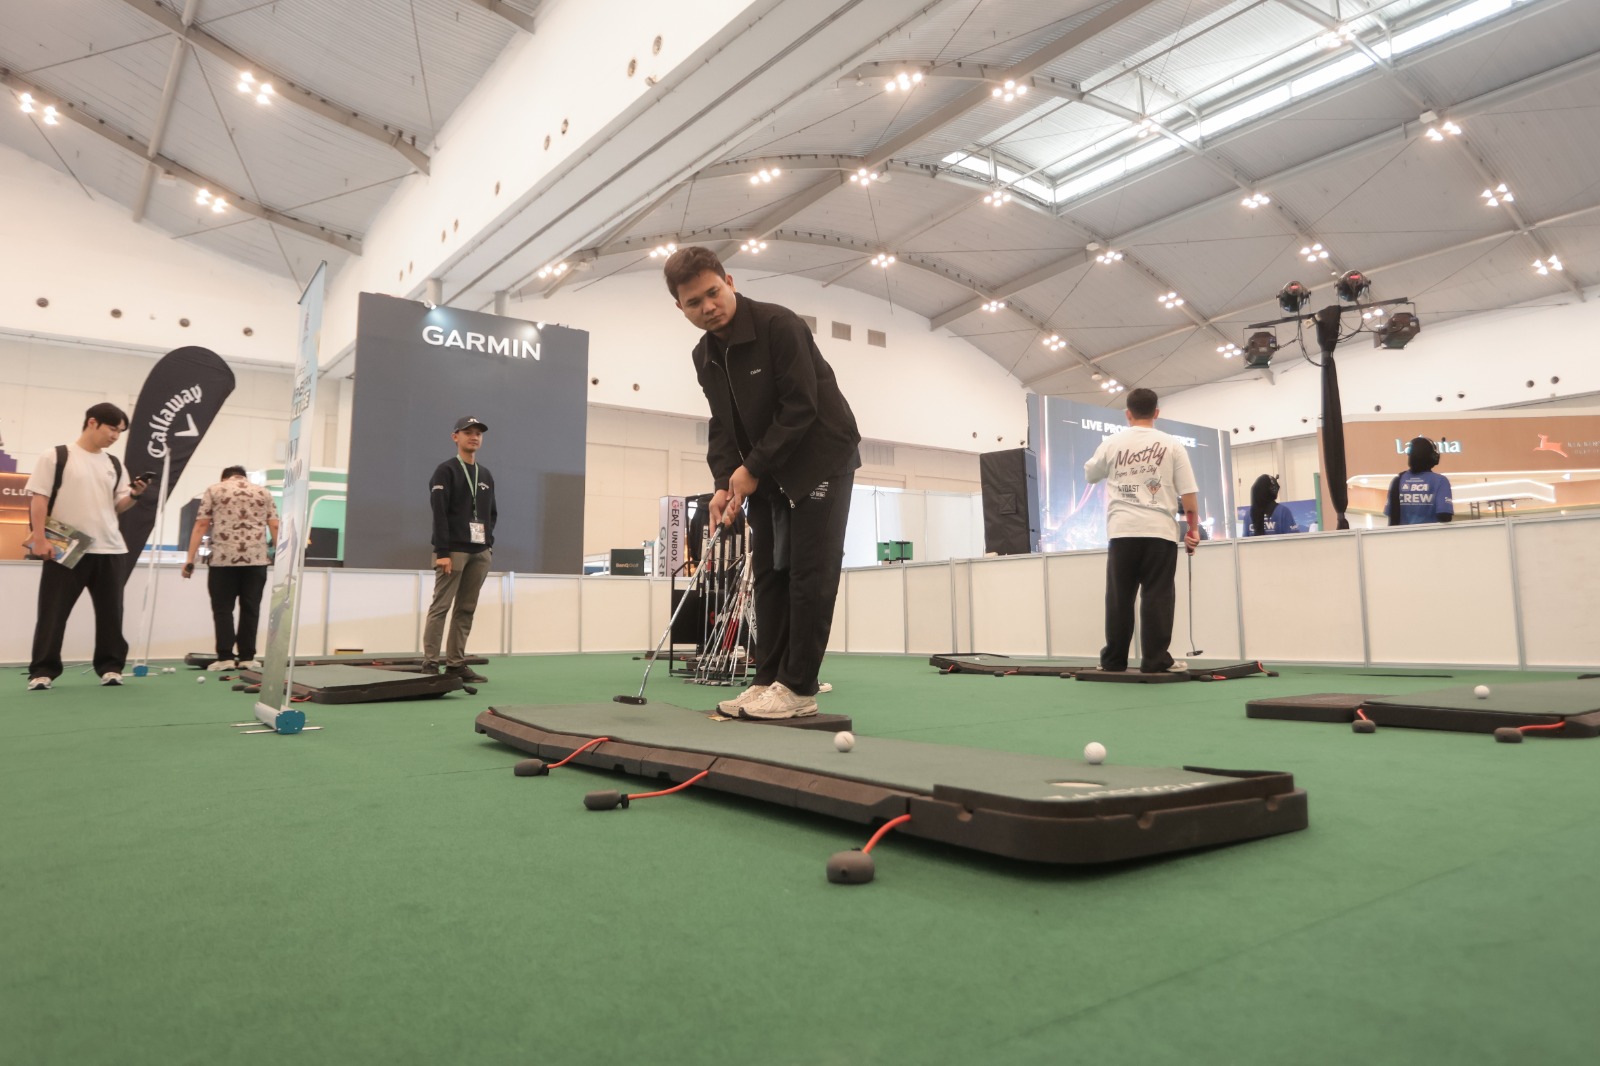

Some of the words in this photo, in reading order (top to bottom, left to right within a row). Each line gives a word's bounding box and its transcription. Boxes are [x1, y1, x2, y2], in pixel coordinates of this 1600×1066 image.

[422, 325, 541, 361] GARMIN
[147, 384, 202, 458] Callaway
[1081, 418, 1102, 432] LIVE
[1103, 422, 1129, 434] PRO
[1410, 483, 1429, 492] BCA
[671, 499, 680, 527] GEAR
[671, 530, 679, 562] UNBOX
